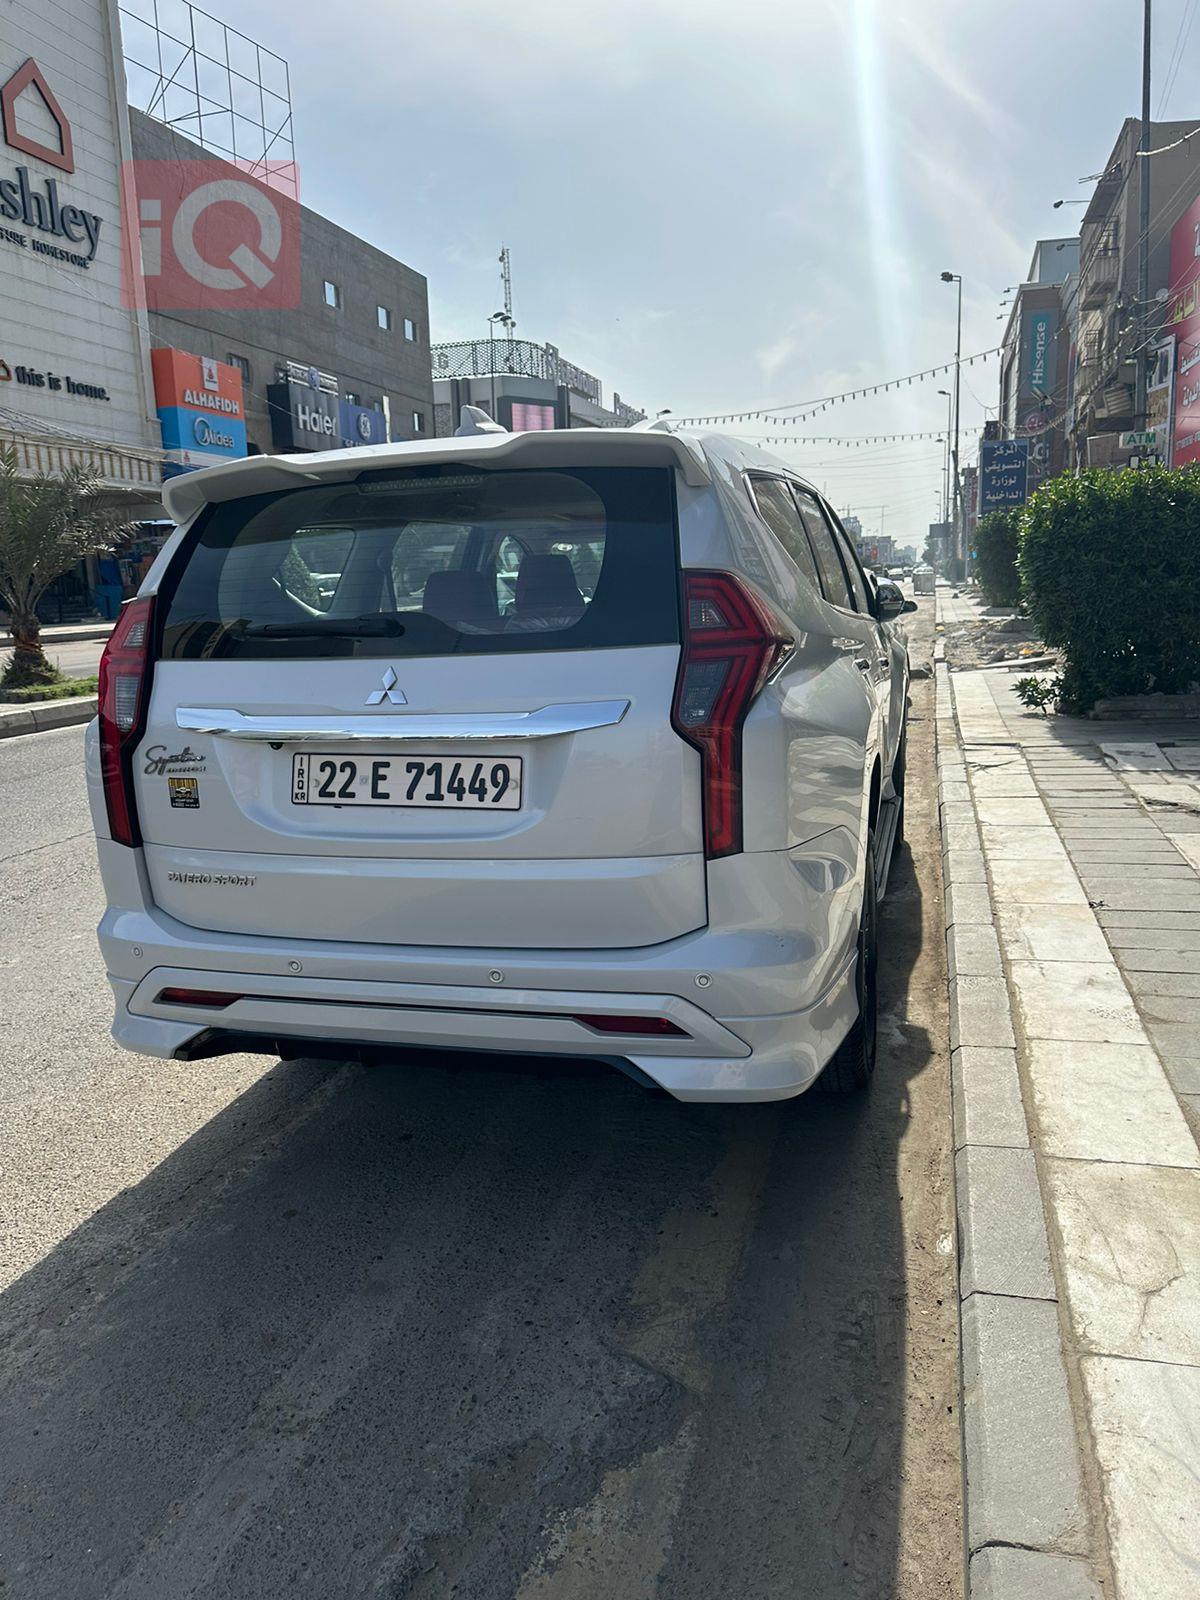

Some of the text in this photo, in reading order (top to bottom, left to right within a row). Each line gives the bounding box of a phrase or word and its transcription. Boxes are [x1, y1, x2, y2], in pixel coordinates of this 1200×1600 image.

[31, 238, 90, 269] HOMESTORE
[1032, 321, 1046, 385] Hisense
[15, 365, 111, 401] this is home.
[184, 389, 240, 415] ALHAFIDH
[195, 418, 235, 448] Midea
[297, 403, 337, 437] Haier
[1126, 432, 1156, 446] ATM
[991, 475, 1017, 487] لوزارة
[985, 490, 1023, 502] الداخلية
[318, 760, 511, 803] 22 E 71449
[294, 792, 306, 801] KR
[168, 871, 256, 887] PAJERO SPORT
